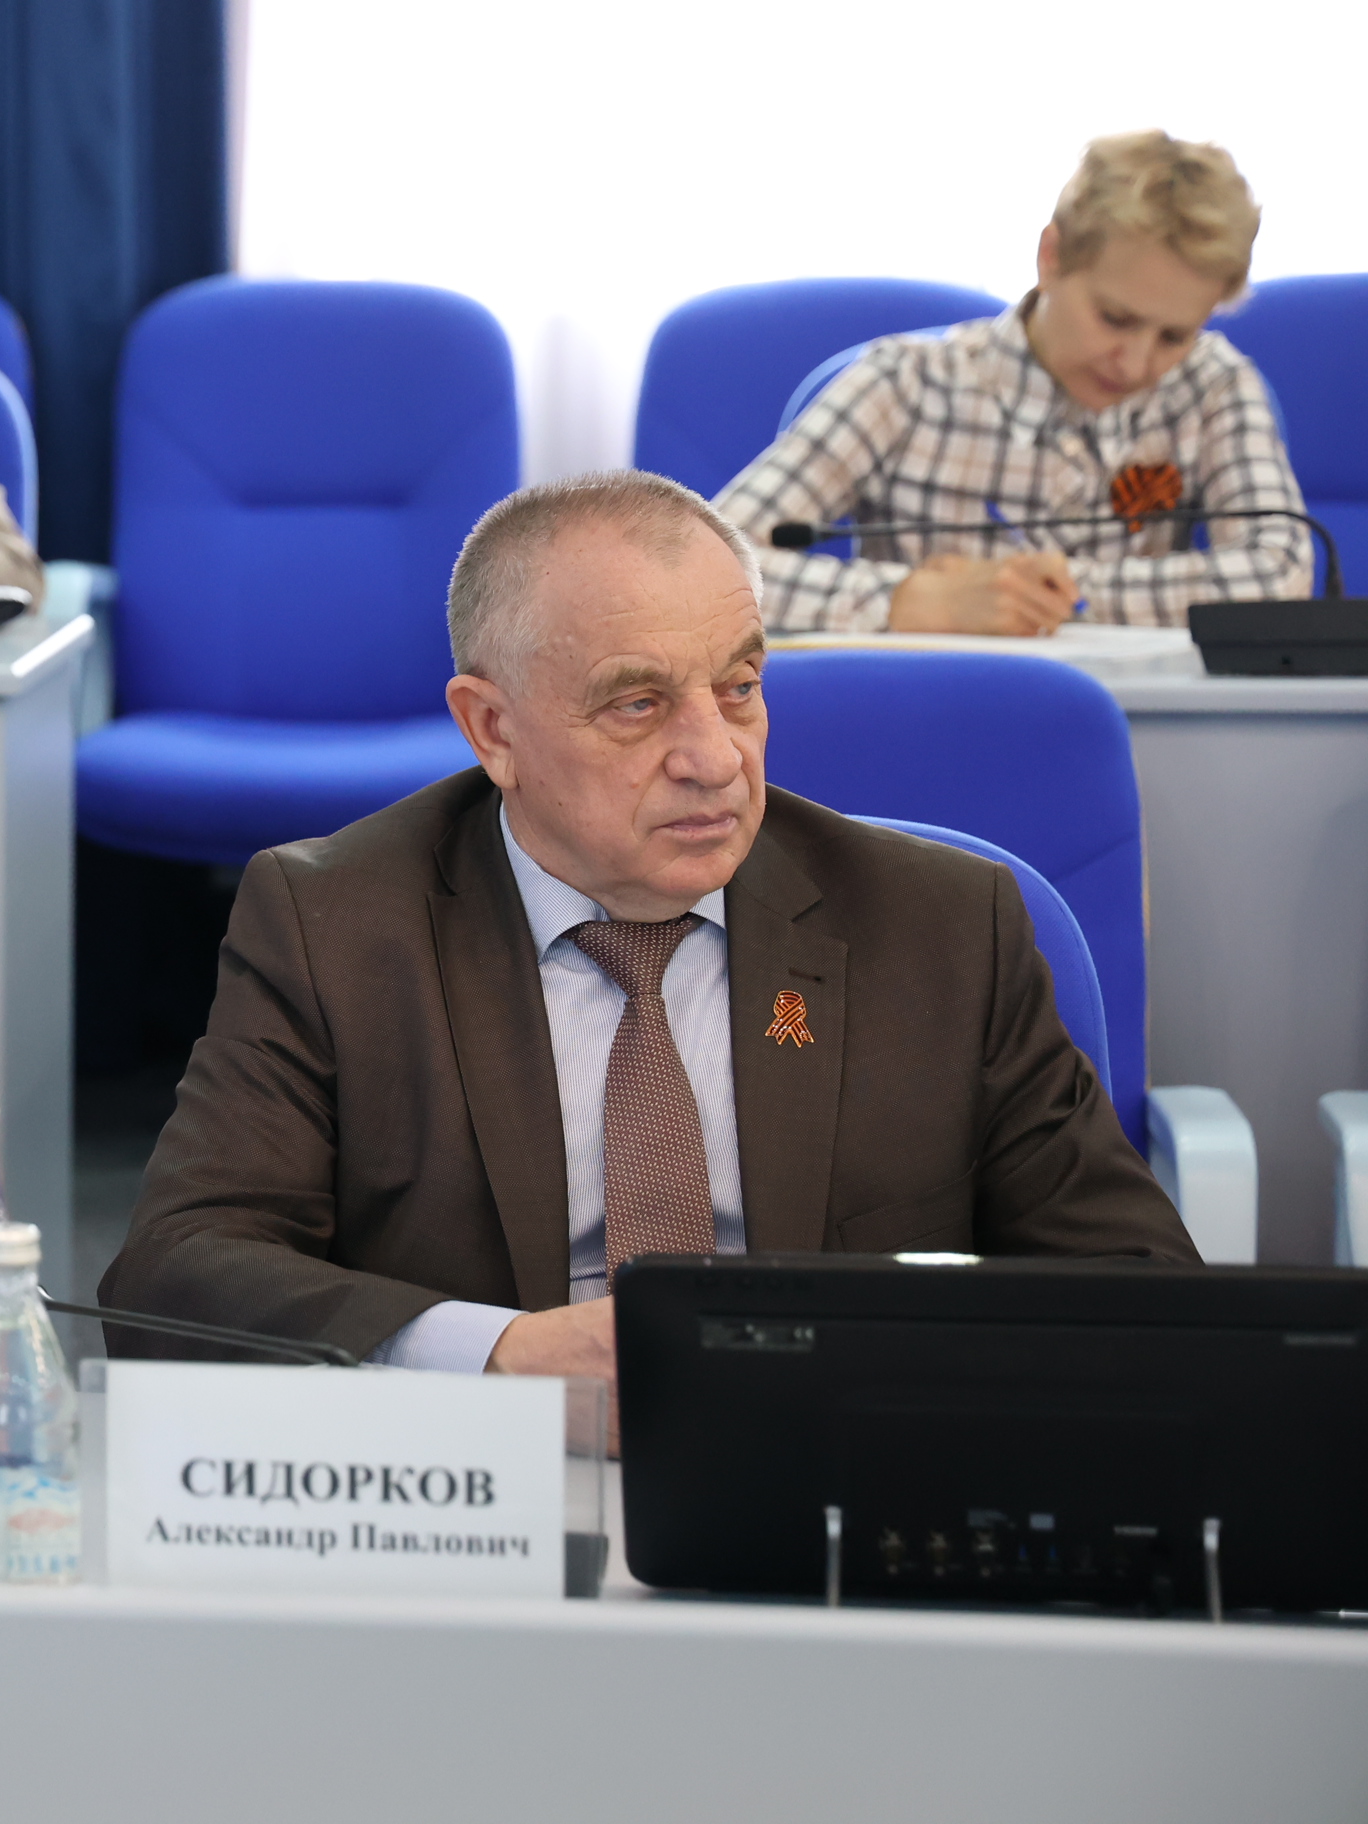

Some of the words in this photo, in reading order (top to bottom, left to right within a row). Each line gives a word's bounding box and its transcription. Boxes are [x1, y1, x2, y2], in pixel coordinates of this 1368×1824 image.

[180, 1457, 496, 1507] СИДОРКОВ
[146, 1517, 337, 1556] Александр
[350, 1522, 531, 1557] Павлович
